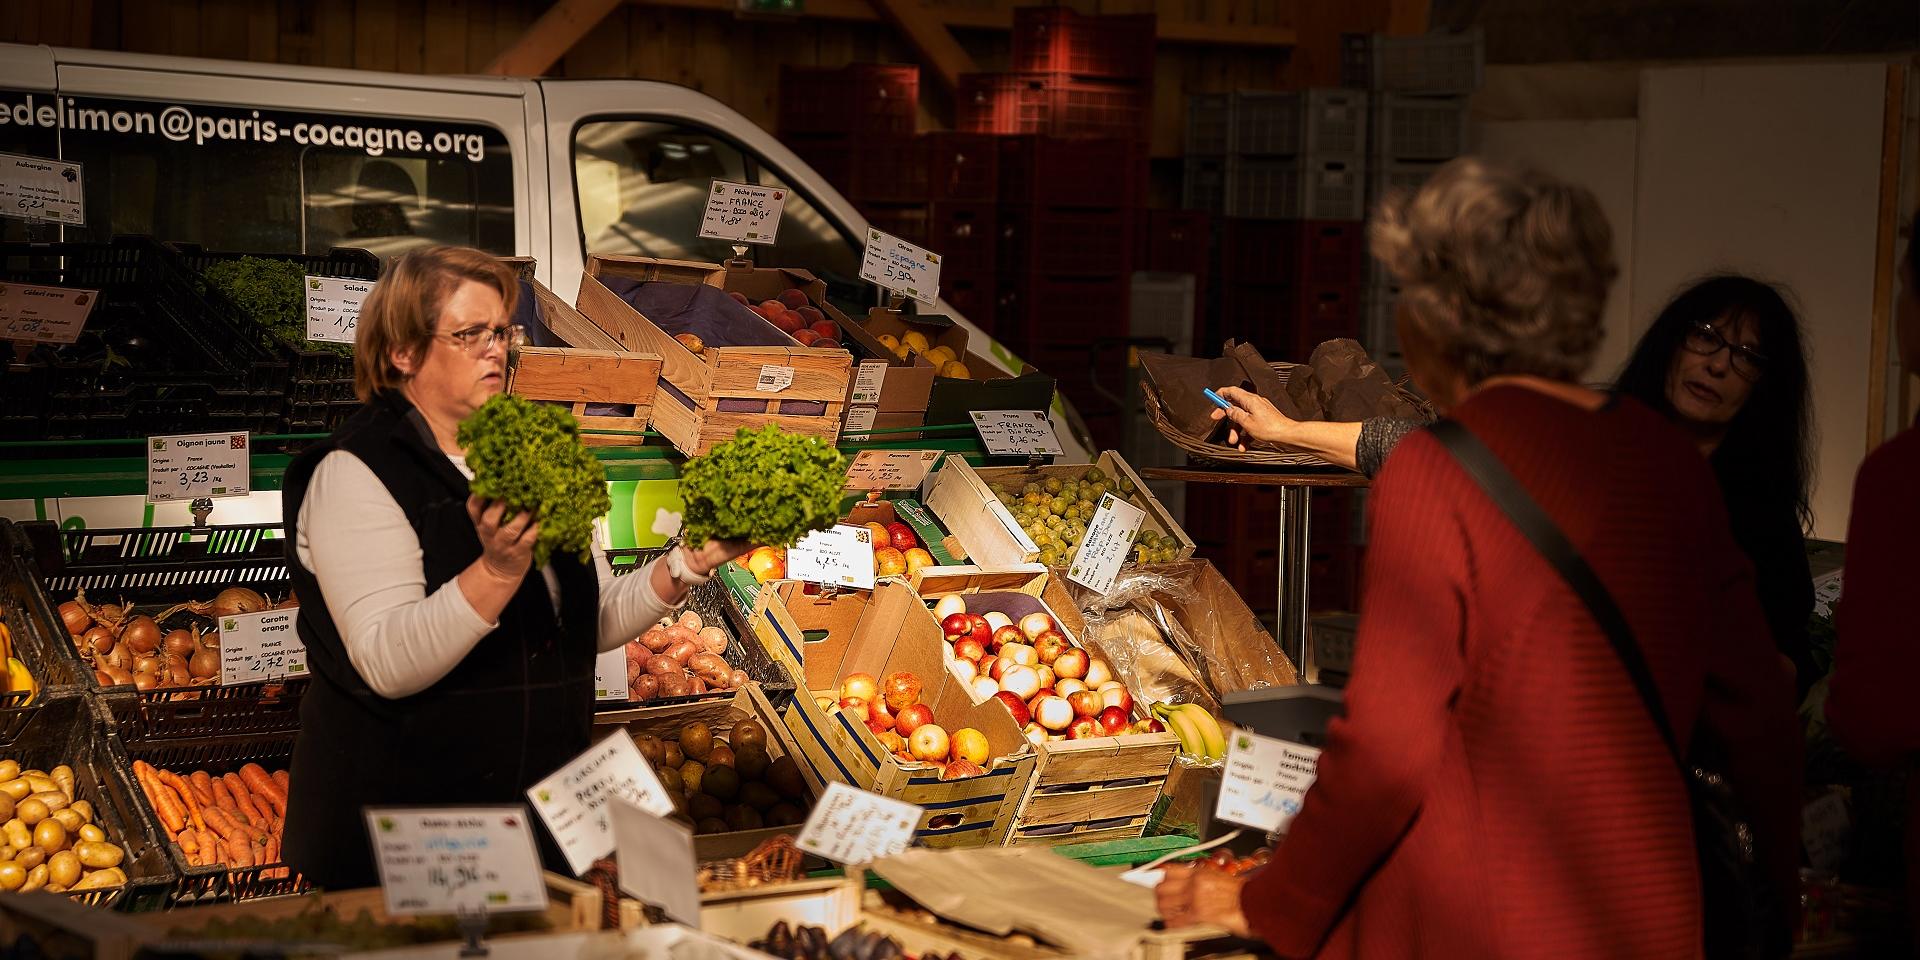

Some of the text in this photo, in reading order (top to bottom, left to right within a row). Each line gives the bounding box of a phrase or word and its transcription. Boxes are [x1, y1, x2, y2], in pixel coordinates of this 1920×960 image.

[16, 161, 52, 171] Aubergine
[734, 188, 767, 198] Pêche jaune
[18, 199, 45, 213] 6,21
[729, 198, 764, 208] FRANCE
[897, 243, 913, 253] Citron
[343, 284, 368, 292] Salade
[333, 315, 361, 334] 1,6
[176, 439, 226, 449] Oignon jaune
[180, 471, 209, 491] 3,23
[261, 615, 289, 624] Carotte
[261, 624, 290, 633] orange
[250, 657, 283, 673] 2,72
